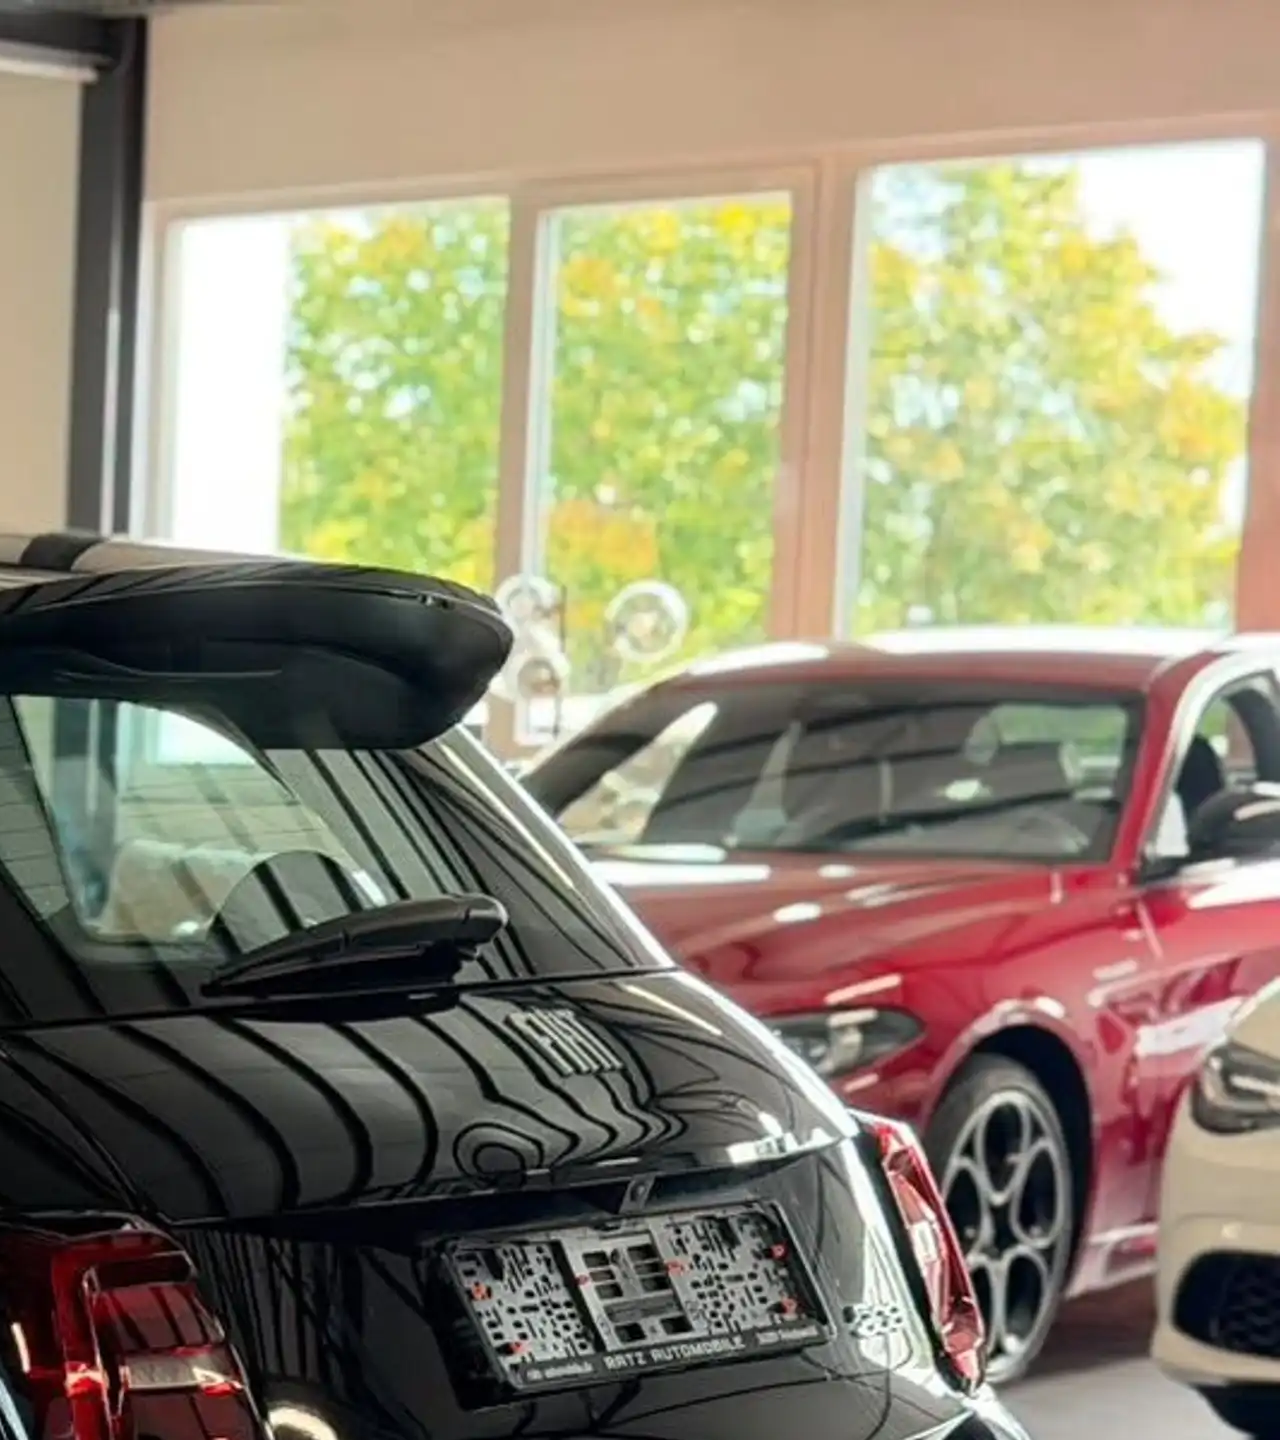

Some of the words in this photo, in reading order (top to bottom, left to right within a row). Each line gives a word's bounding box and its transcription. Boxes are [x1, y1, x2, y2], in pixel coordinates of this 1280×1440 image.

[504, 1007, 624, 1076] FIAT
[603, 1351, 647, 1370] RATZ
[651, 1335, 746, 1362] AUTOMOBILE
